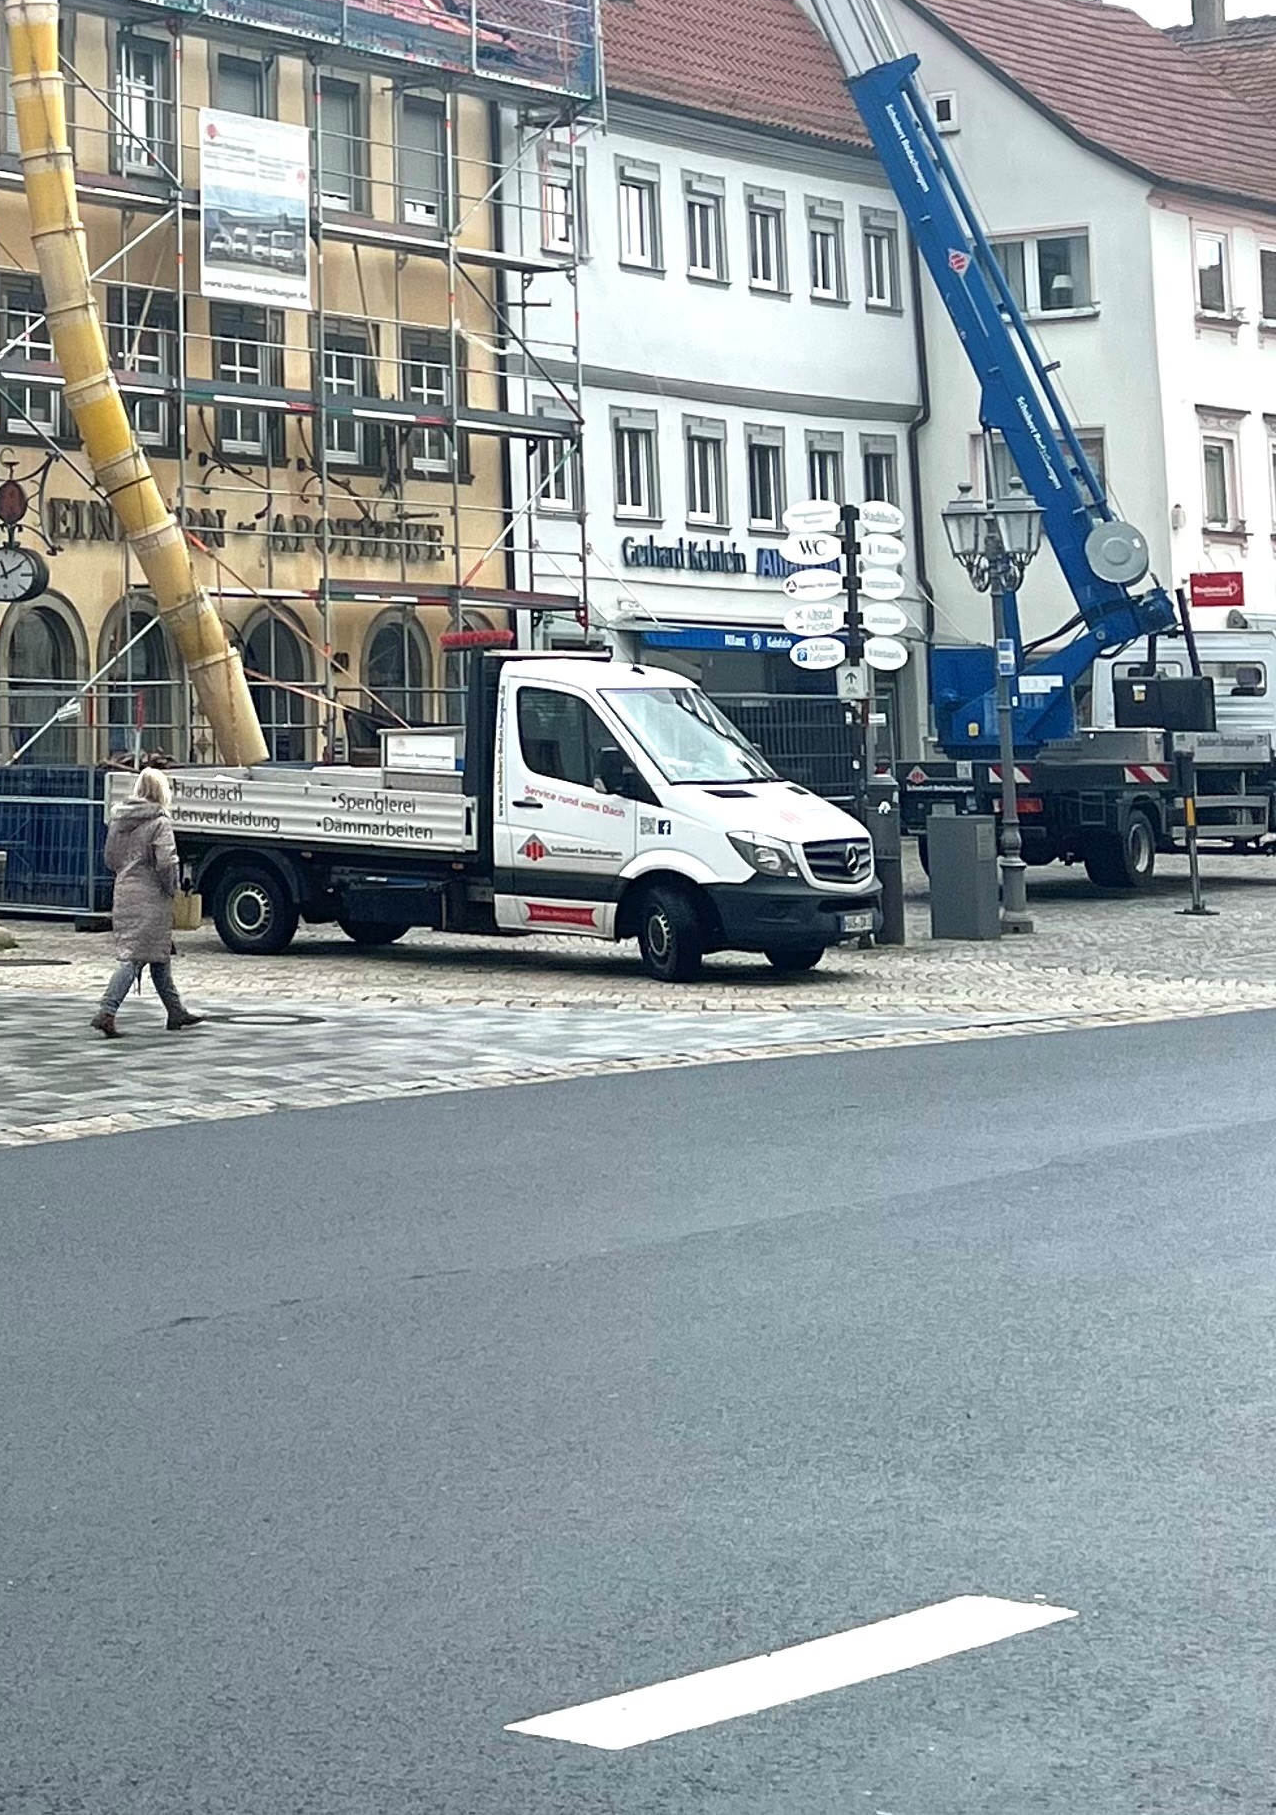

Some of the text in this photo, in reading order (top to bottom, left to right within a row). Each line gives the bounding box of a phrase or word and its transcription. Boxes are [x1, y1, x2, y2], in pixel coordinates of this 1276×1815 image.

[272, 513, 445, 562] APOTHEKE
[798, 539, 827, 557] WC
[172, 778, 243, 801] Flachdach
[337, 792, 416, 815] Spenglerei
[525, 785, 626, 818] Service rund ums Dach
[323, 816, 433, 840] Dämmarbeiten
